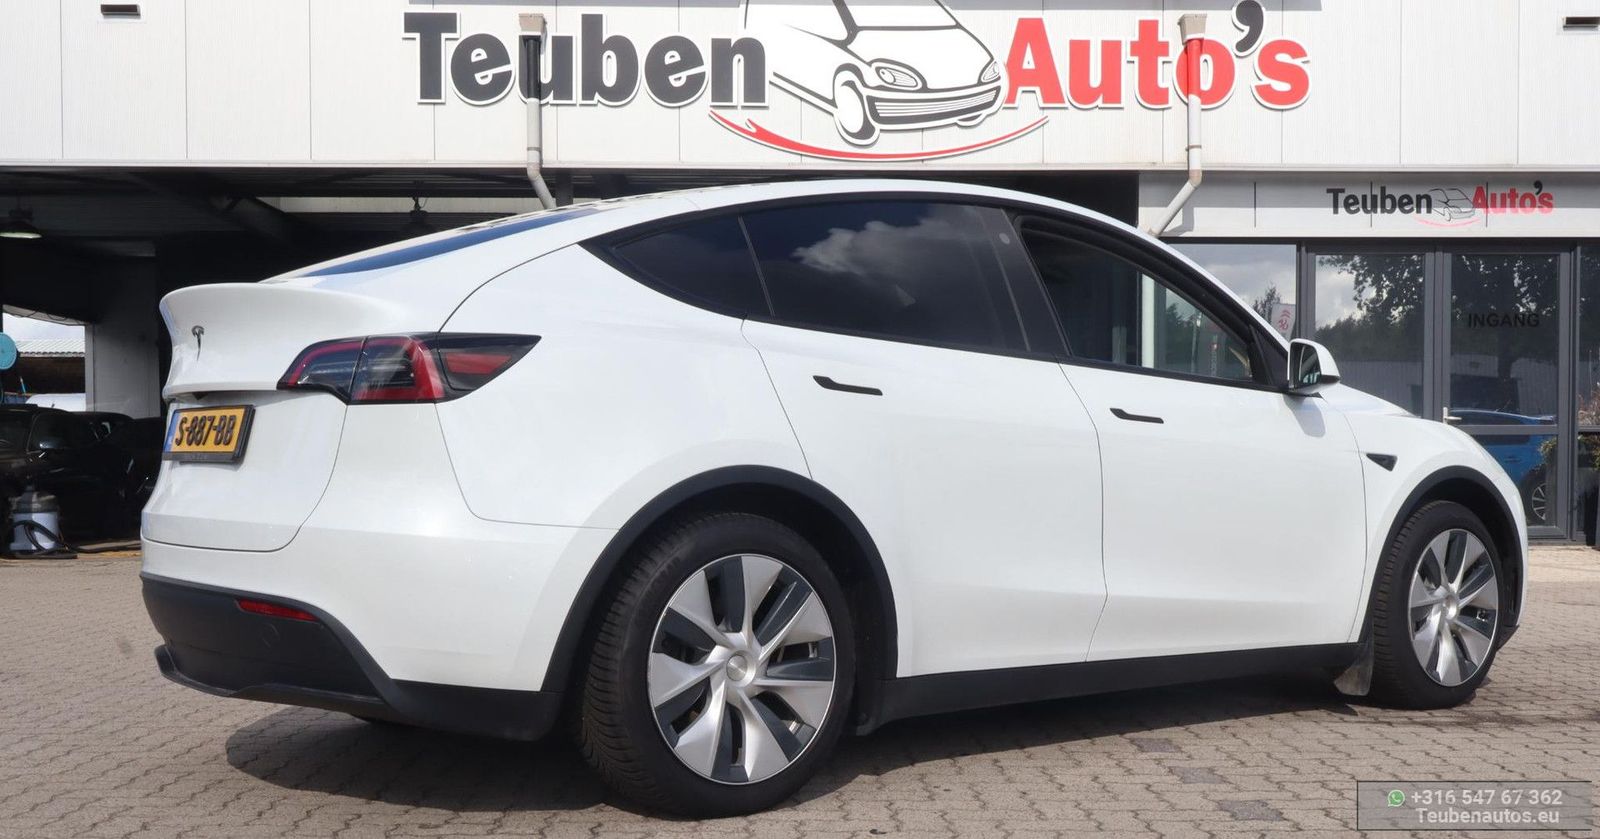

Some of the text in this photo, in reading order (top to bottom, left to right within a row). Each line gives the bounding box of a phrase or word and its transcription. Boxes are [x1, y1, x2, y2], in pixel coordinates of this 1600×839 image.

[403, 0, 1310, 106] Teuben Auto's
[1326, 180, 1554, 215] Teuben Auto's
[1468, 312, 1540, 328] INGANG
[174, 414, 237, 447] S-887-BB
